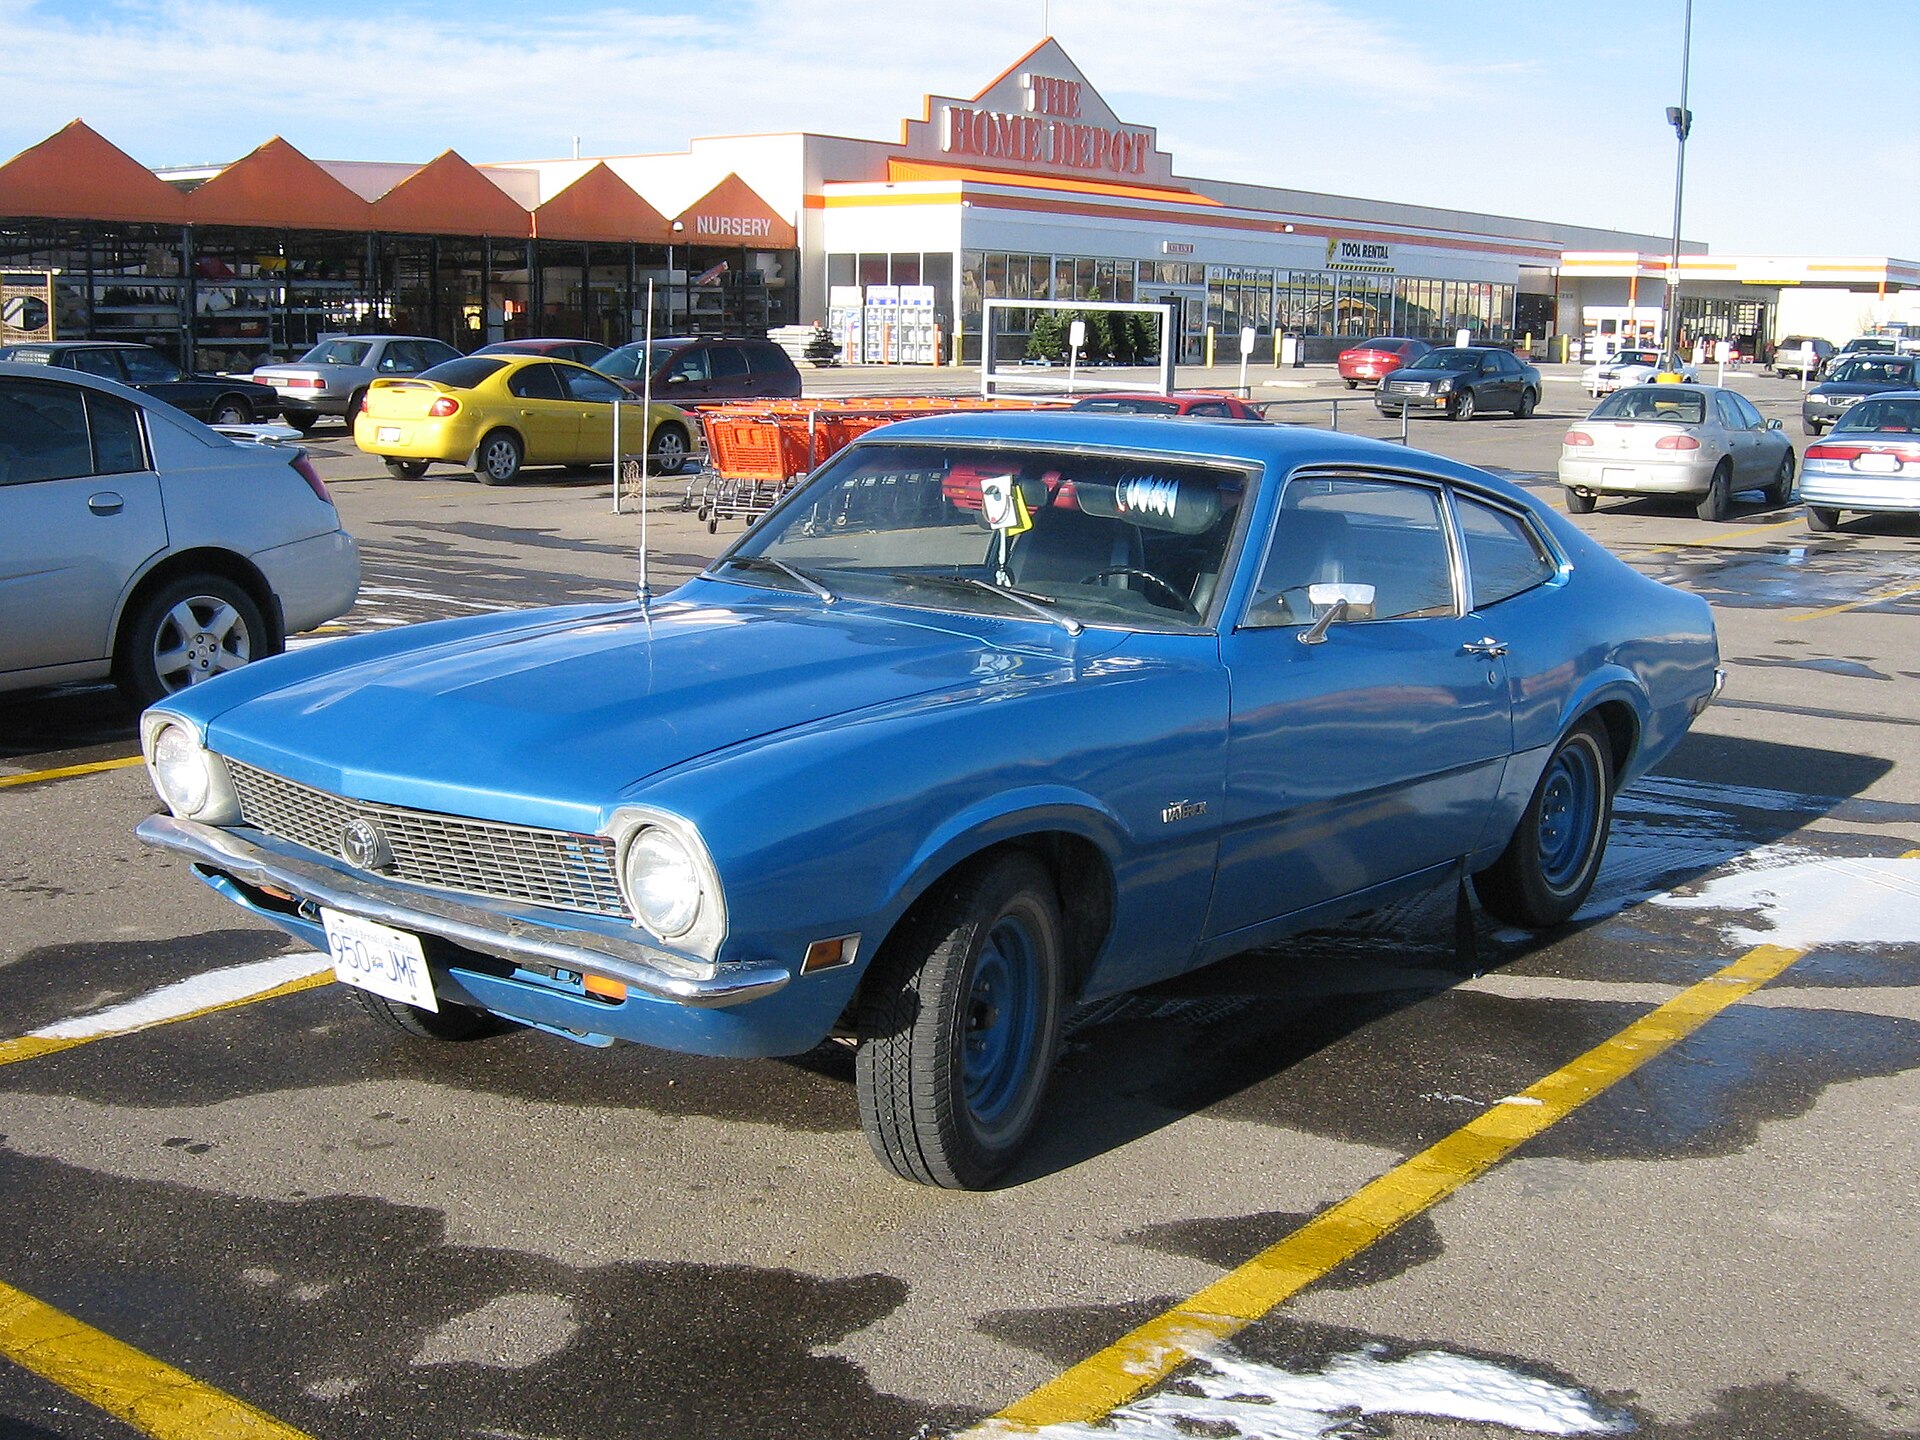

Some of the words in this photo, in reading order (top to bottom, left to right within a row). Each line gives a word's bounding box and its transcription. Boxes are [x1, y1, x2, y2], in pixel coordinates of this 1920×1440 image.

[1023, 72, 1082, 118] THE
[941, 106, 1043, 161] HOME
[1047, 121, 1150, 174] DEPOT
[697, 216, 771, 236] NURSERY
[1342, 242, 1361, 257] TOOL
[1362, 245, 1389, 259] RENTAL
[330, 932, 371, 972] 950
[386, 949, 418, 988] JMF
